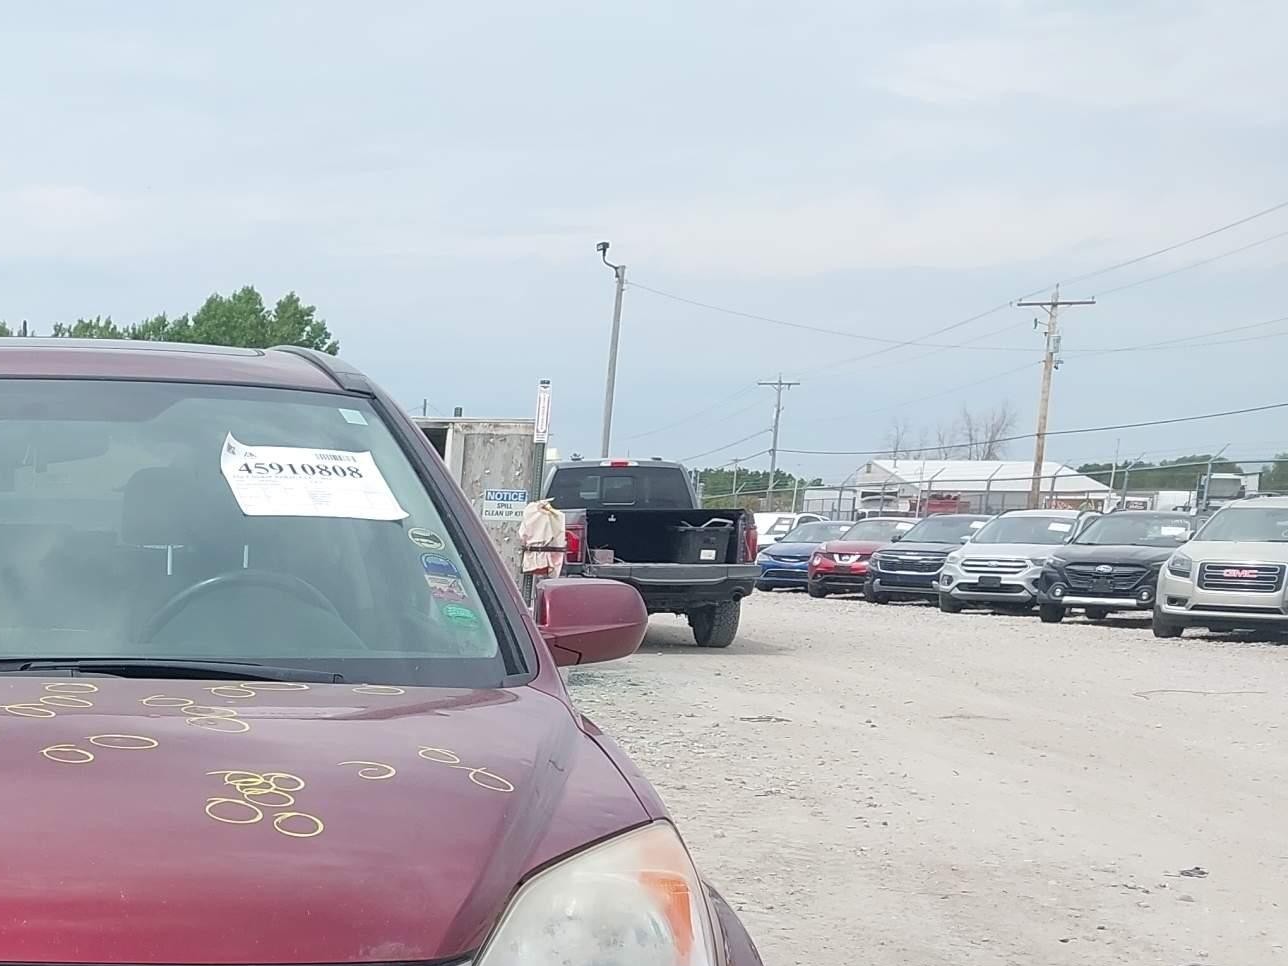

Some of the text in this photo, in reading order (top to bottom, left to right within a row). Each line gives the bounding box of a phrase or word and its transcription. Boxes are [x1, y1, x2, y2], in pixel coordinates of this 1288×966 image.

[238, 462, 364, 479] 45910808
[487, 491, 525, 501] NOTICE
[1223, 569, 1258, 578] GMC
